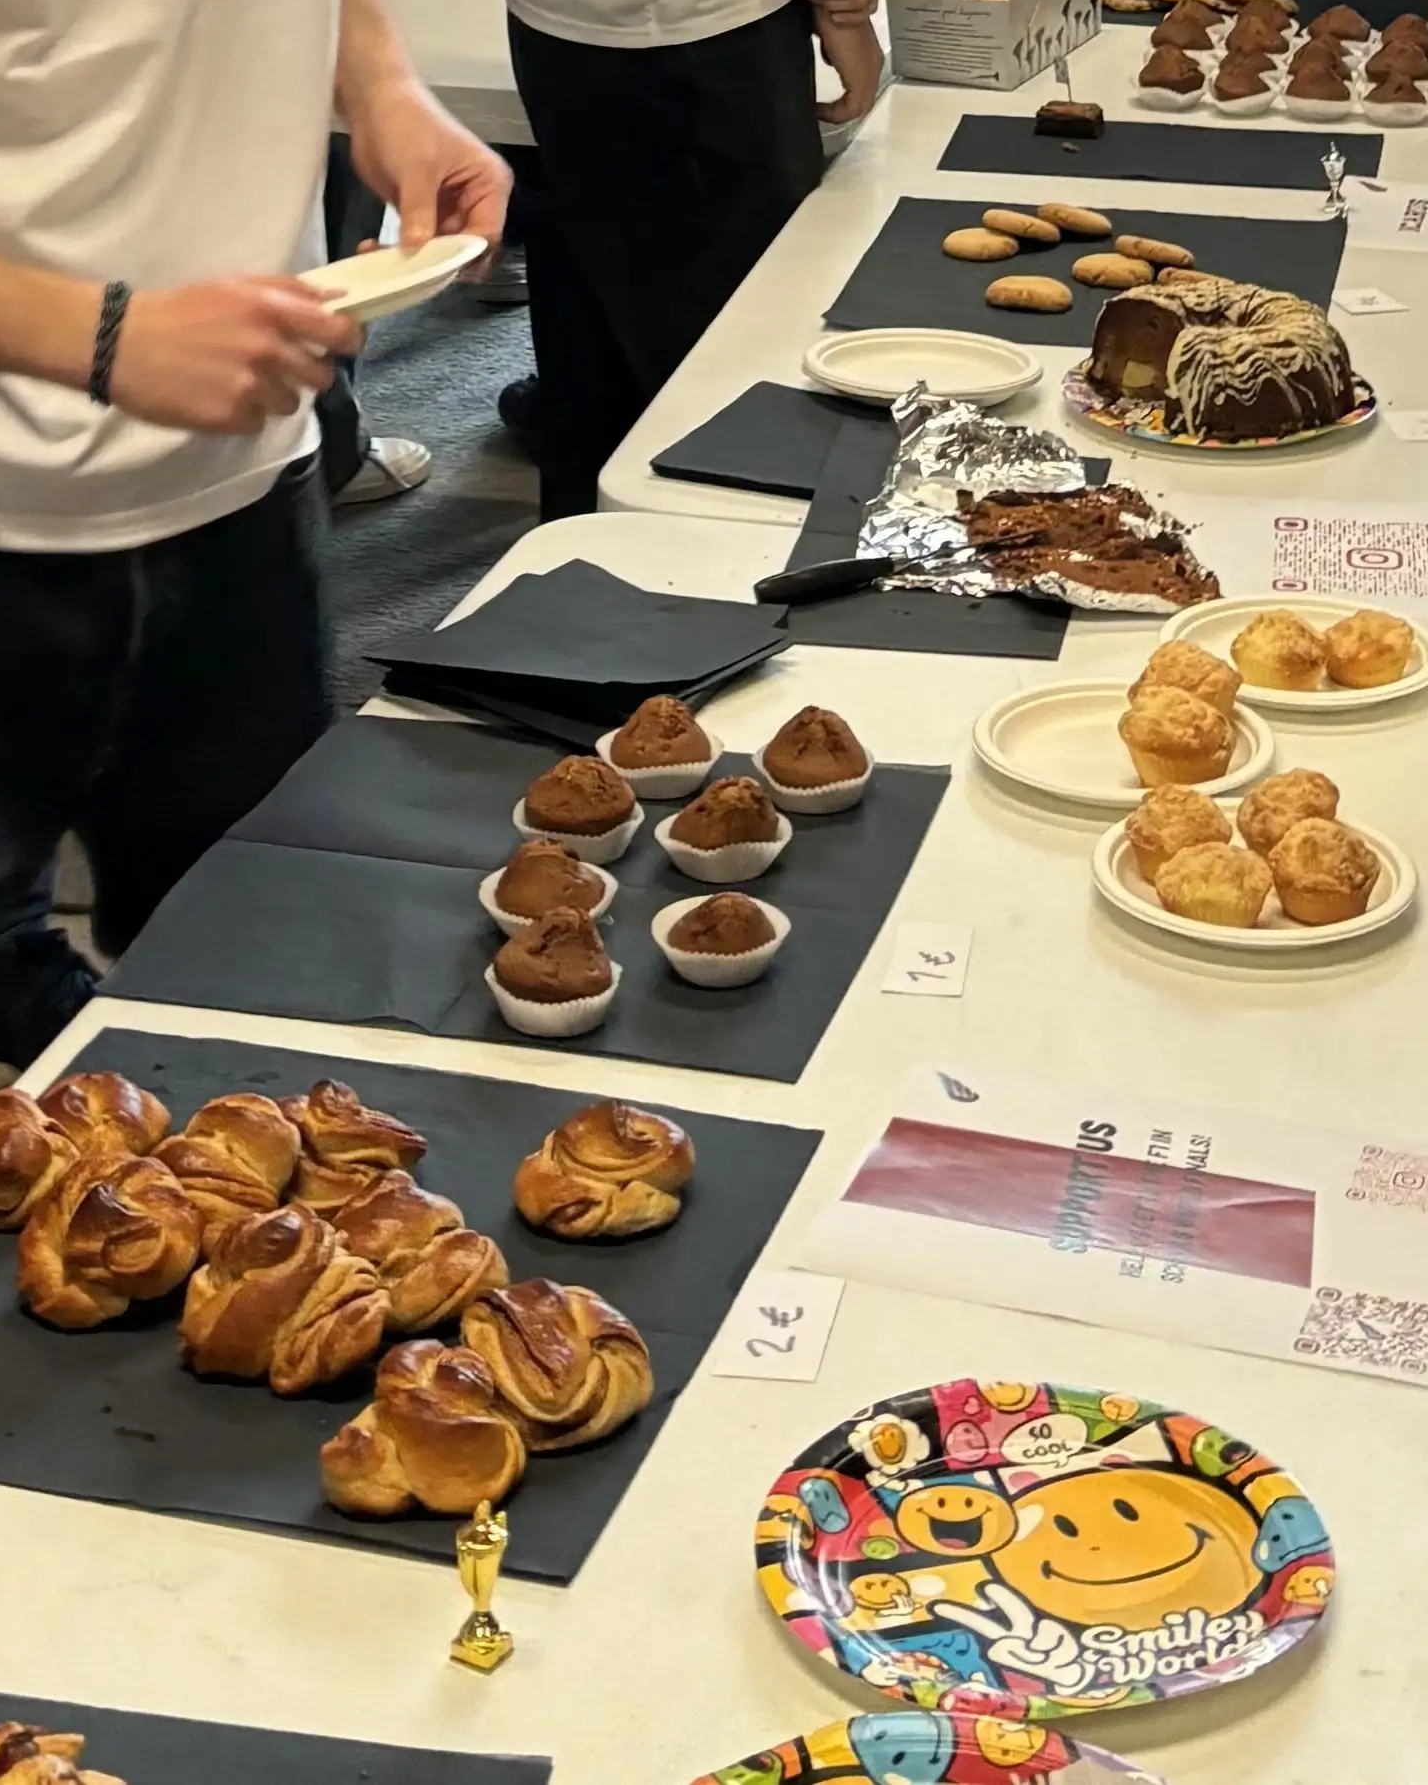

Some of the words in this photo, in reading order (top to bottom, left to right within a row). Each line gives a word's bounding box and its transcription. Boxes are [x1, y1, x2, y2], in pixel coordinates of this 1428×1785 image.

[1076, 1120, 1118, 1153] US
[1049, 1153, 1110, 1254] SUPPORT
[1022, 1440, 1075, 1459] COOL
[1028, 1423, 1053, 1441] SO
[1081, 1607, 1265, 1654] Smiley
[1095, 1636, 1252, 1684] World
